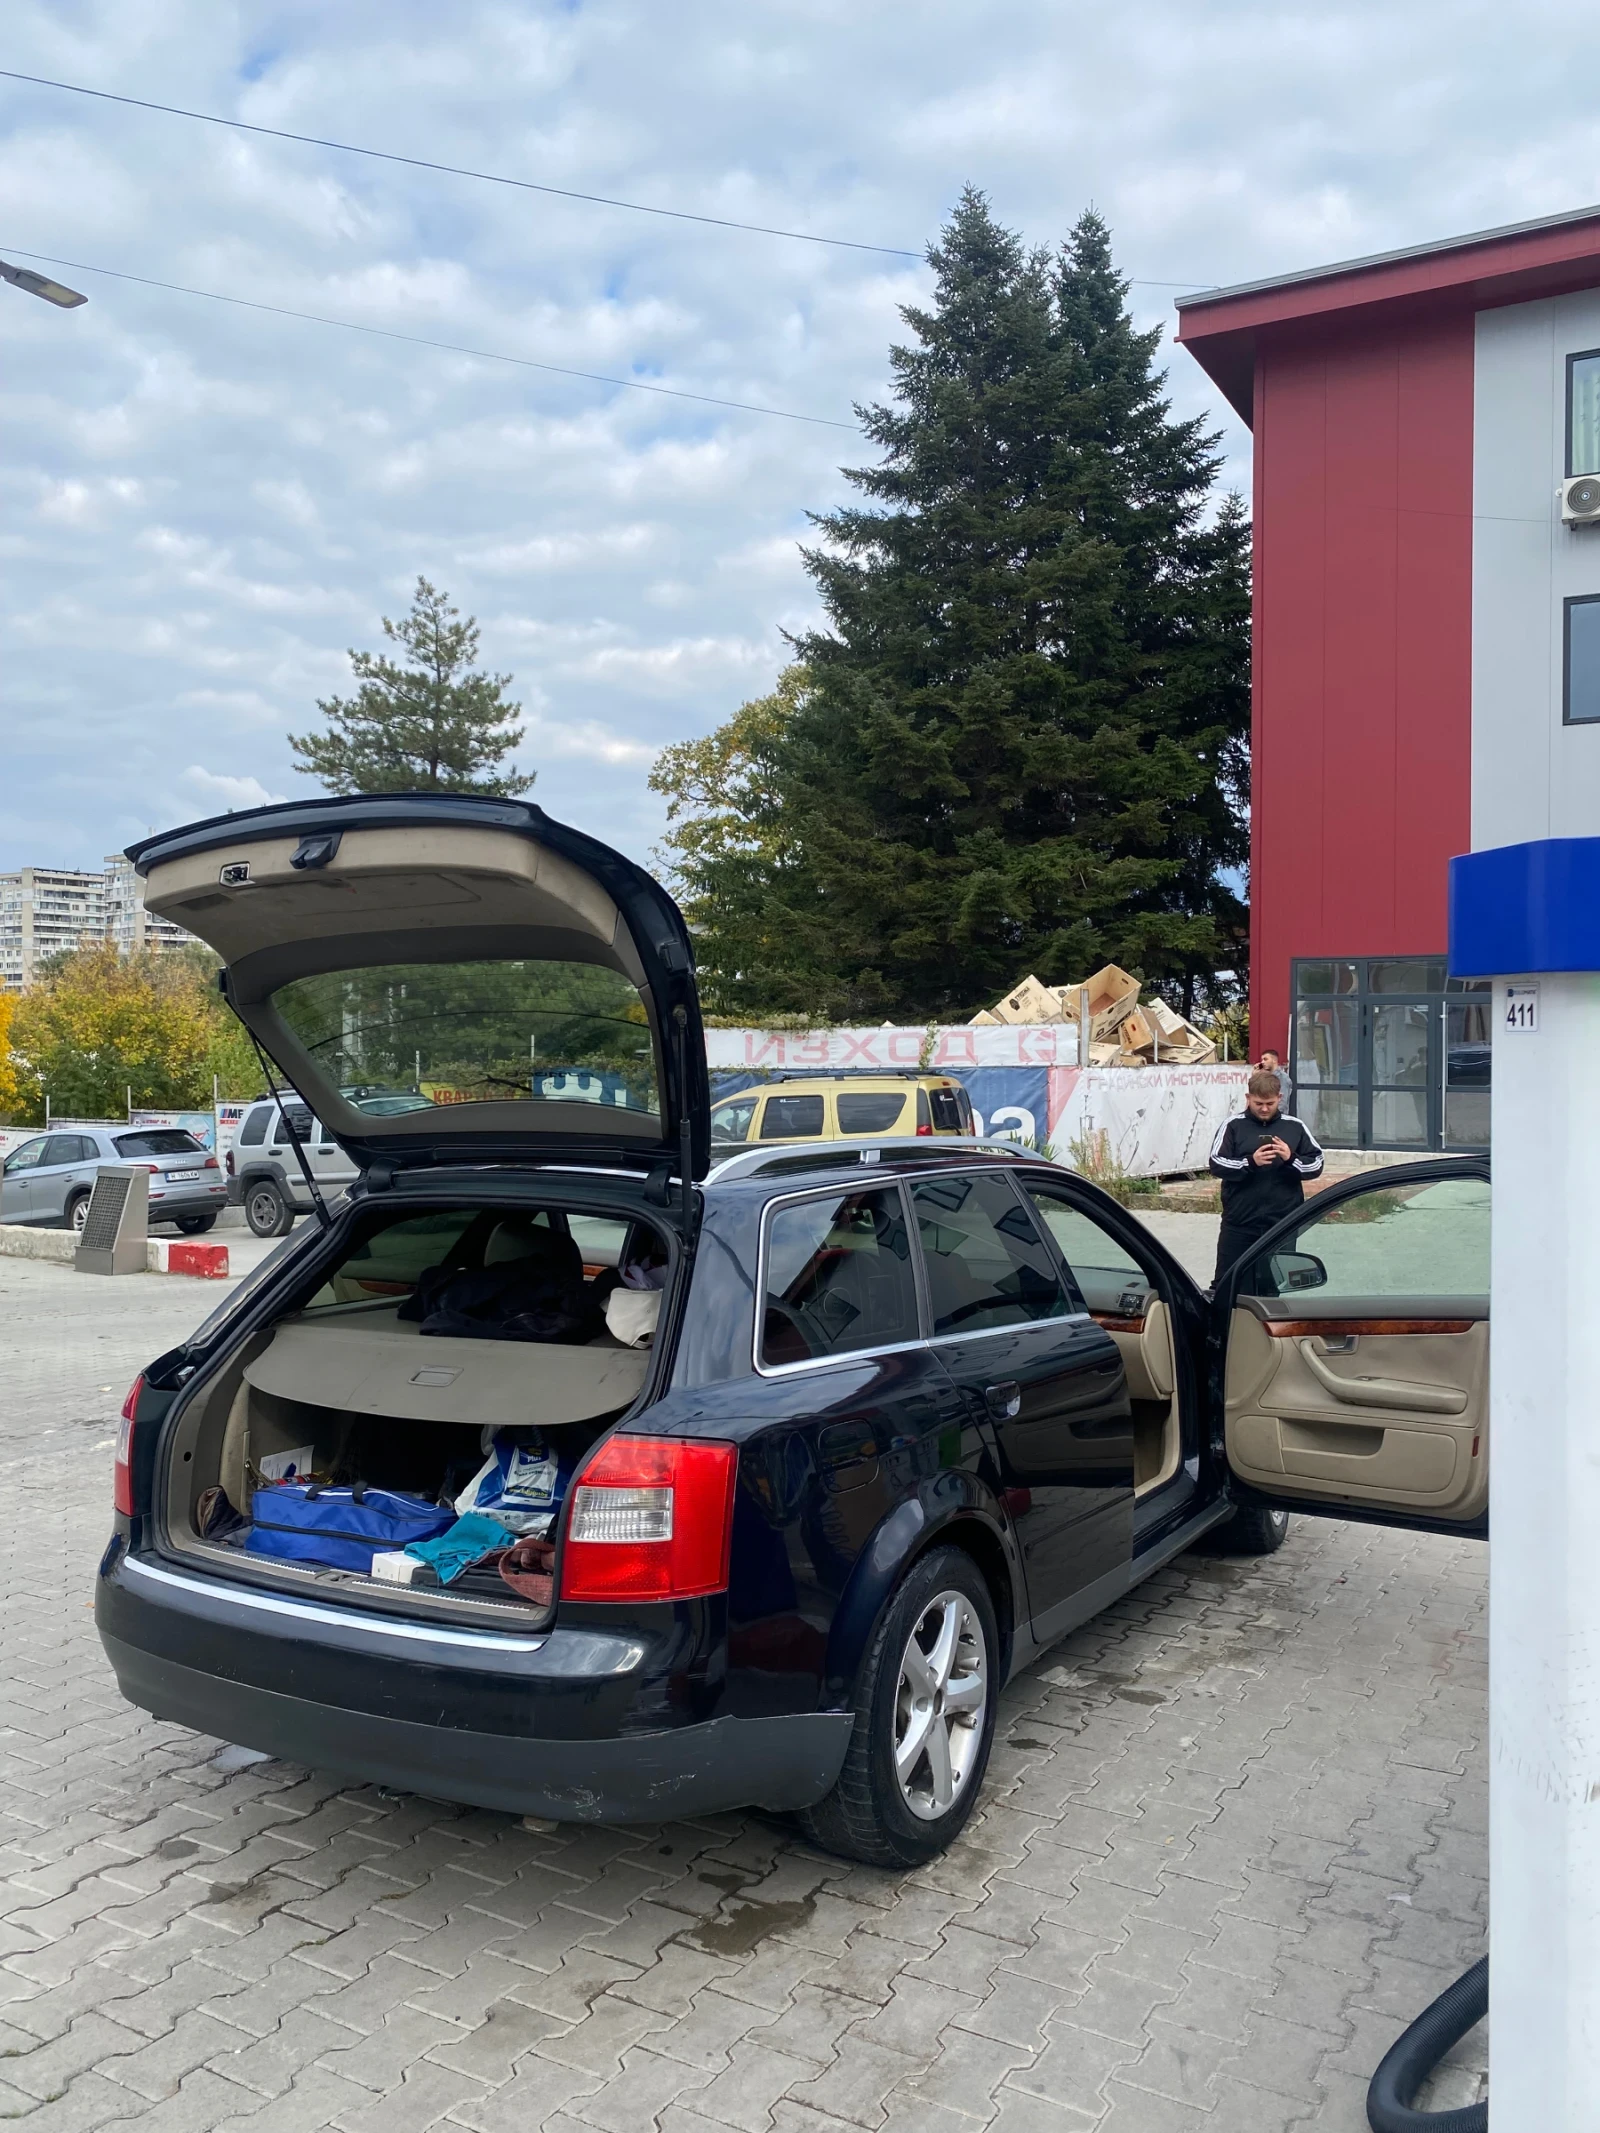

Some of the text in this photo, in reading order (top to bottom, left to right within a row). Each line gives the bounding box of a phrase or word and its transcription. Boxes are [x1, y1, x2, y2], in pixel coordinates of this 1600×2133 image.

[1507, 1003, 1533, 1027] 411
[745, 1031, 979, 1067] ИЗХОД
[1087, 1072, 1248, 1091] ГРАДИНСКИ ИНСТРУМЕНТИ
